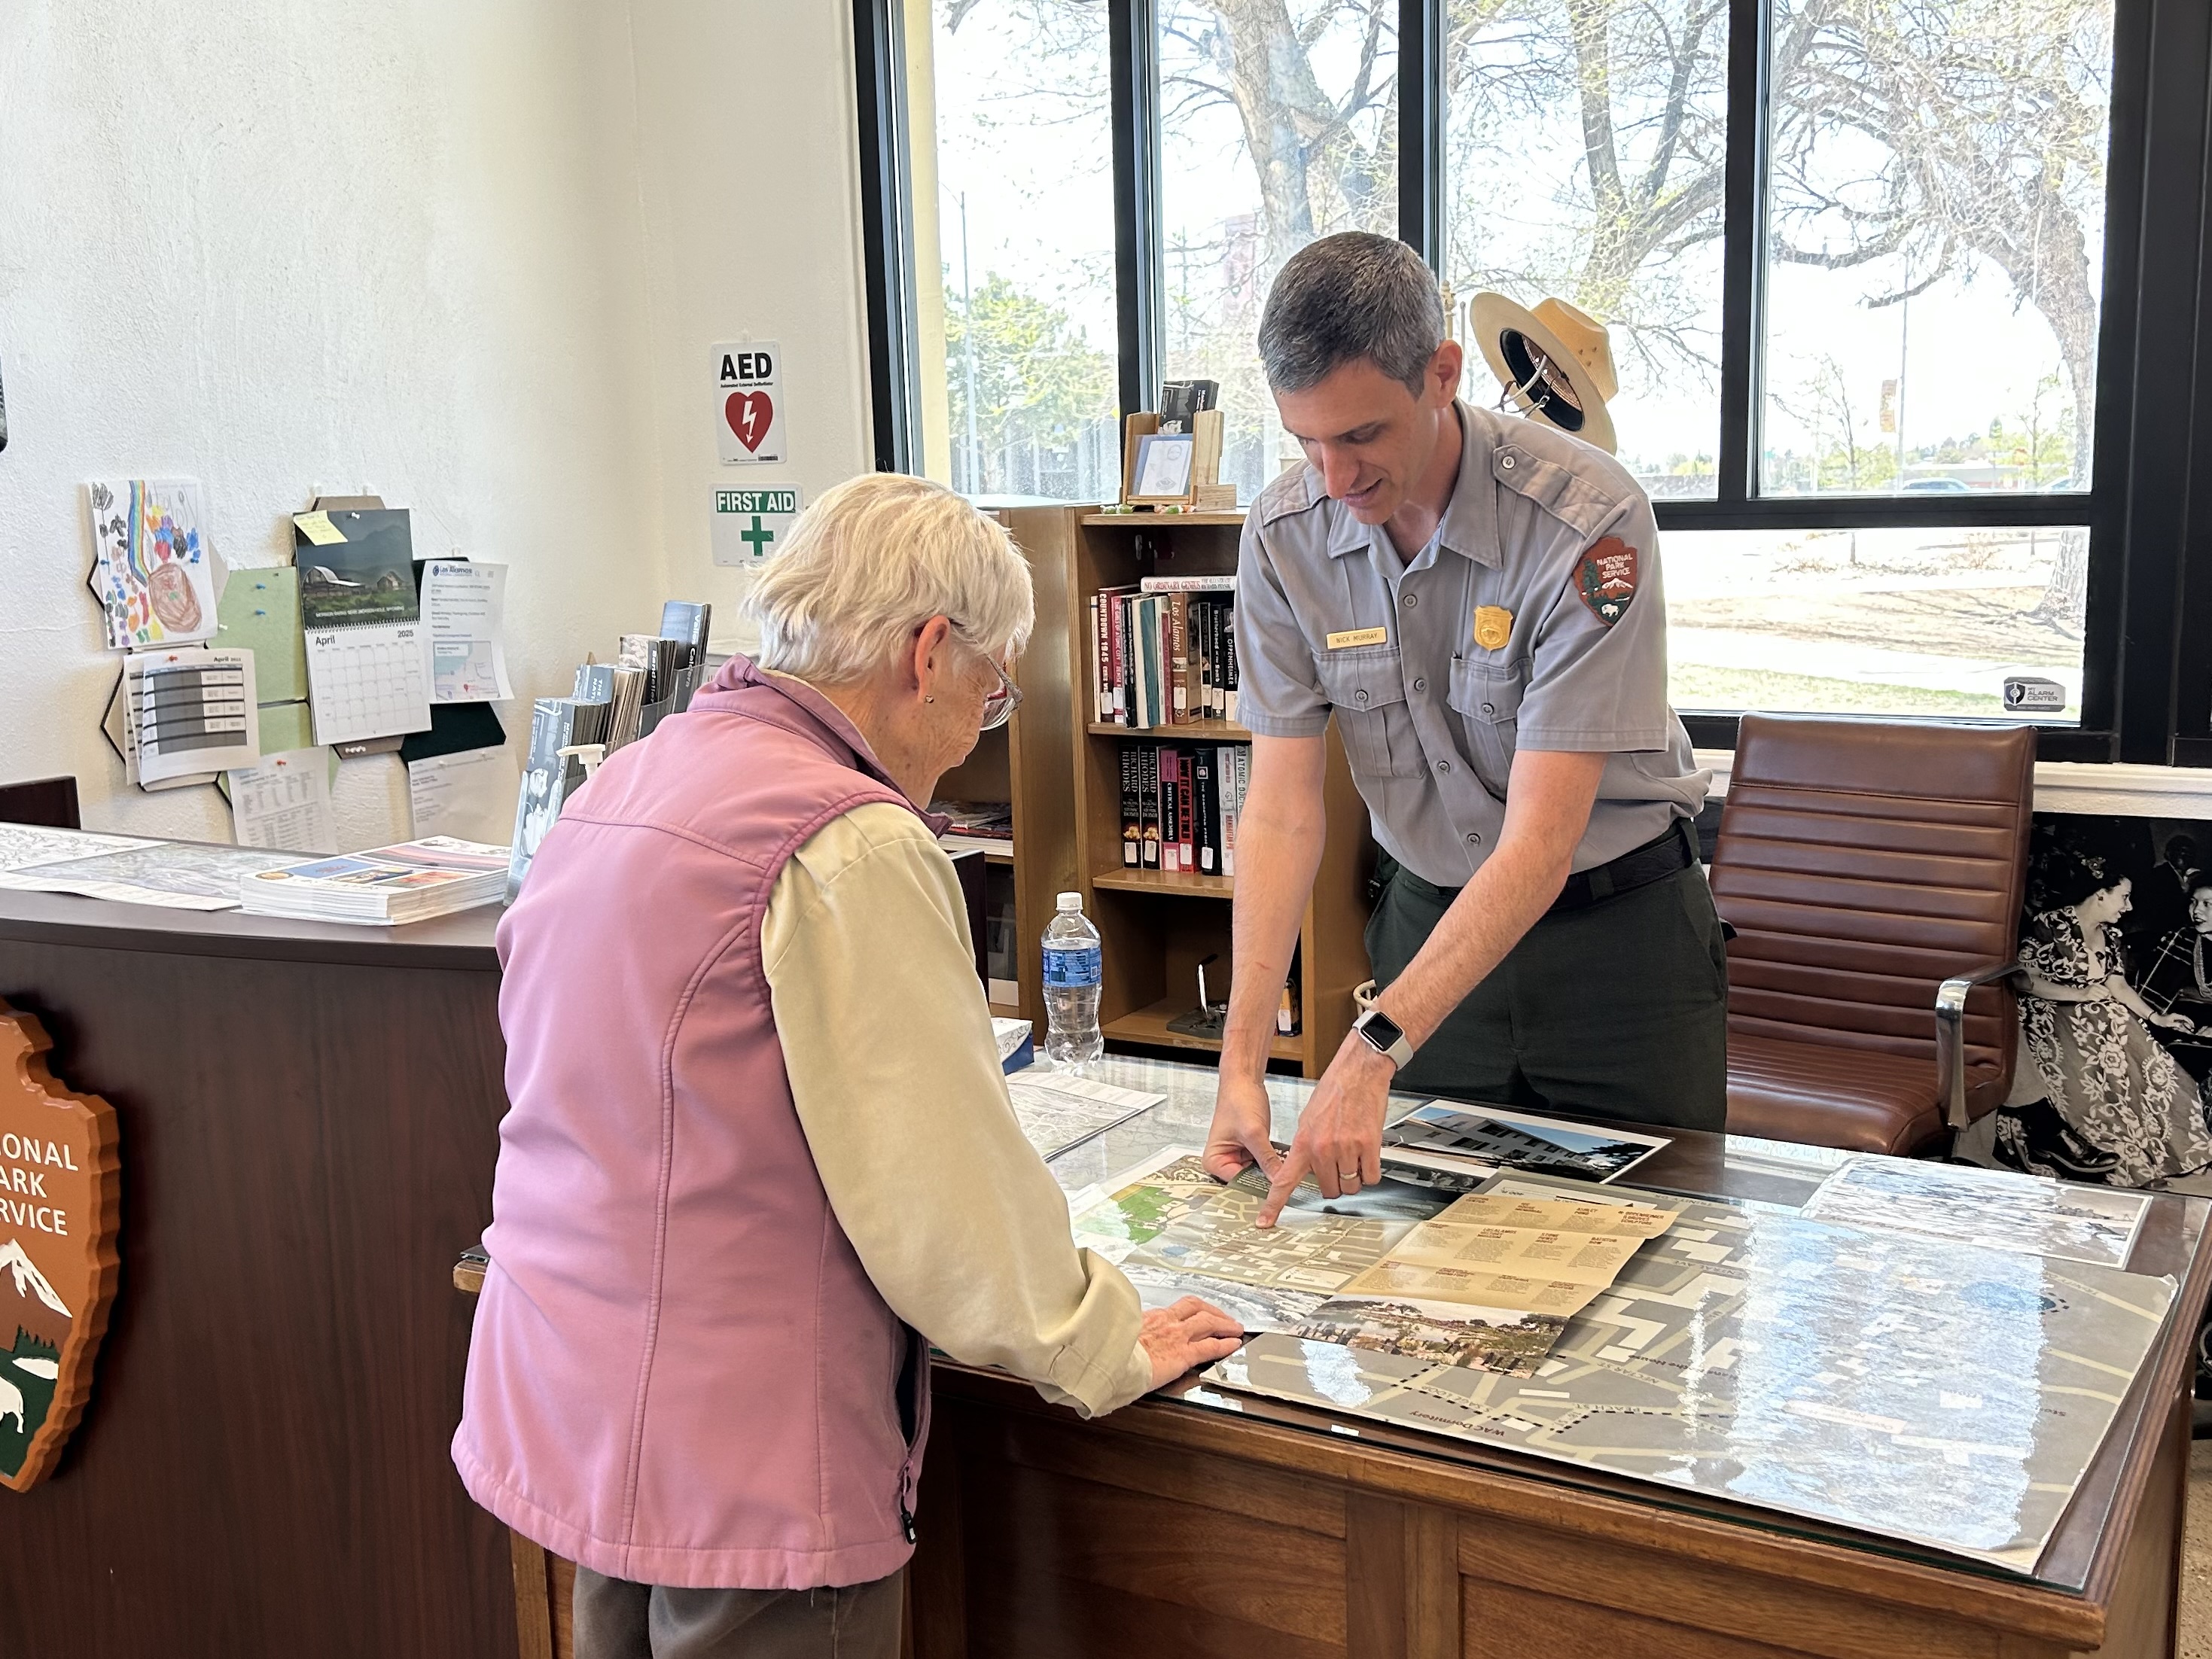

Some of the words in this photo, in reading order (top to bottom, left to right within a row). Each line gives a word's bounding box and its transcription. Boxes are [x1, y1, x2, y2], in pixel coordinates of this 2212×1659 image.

[721, 352, 772, 380] AED
[717, 492, 763, 512] FIRST
[766, 492, 794, 512] AID
[1596, 553, 1634, 566] NATIONAL
[1605, 562, 1625, 571] PARK
[1601, 567, 1631, 579] SERVICE
[1099, 593, 1108, 639] COUNTDOWN
[1172, 601, 1181, 616] Los
[316, 635, 336, 647] April
[397, 629, 414, 638] 2025
[691, 614, 701, 645] Valles
[1172, 617, 1184, 652] Alamos
[1353, 633, 1378, 641] MURRAY
[1101, 641, 1109, 663] 1945
[1122, 752, 1131, 793] RHODES
[1130, 752, 1138, 793] RICHARD
[1141, 752, 1150, 793] RHODES
[1180, 759, 1190, 778] NOW
[1237, 757, 1246, 784] ATOMIC
[1180, 779, 1190, 787] IT
[1181, 788, 1190, 806] CAN
[1181, 818, 1190, 839] TOLD
[0, 1133, 78, 1171] ONAL
[0, 1198, 69, 1236] RVICE
[1595, 1404, 1641, 1412] PEACH
[1409, 1411, 1473, 1429] Dormitory
[1474, 1425, 1505, 1437] WAC
